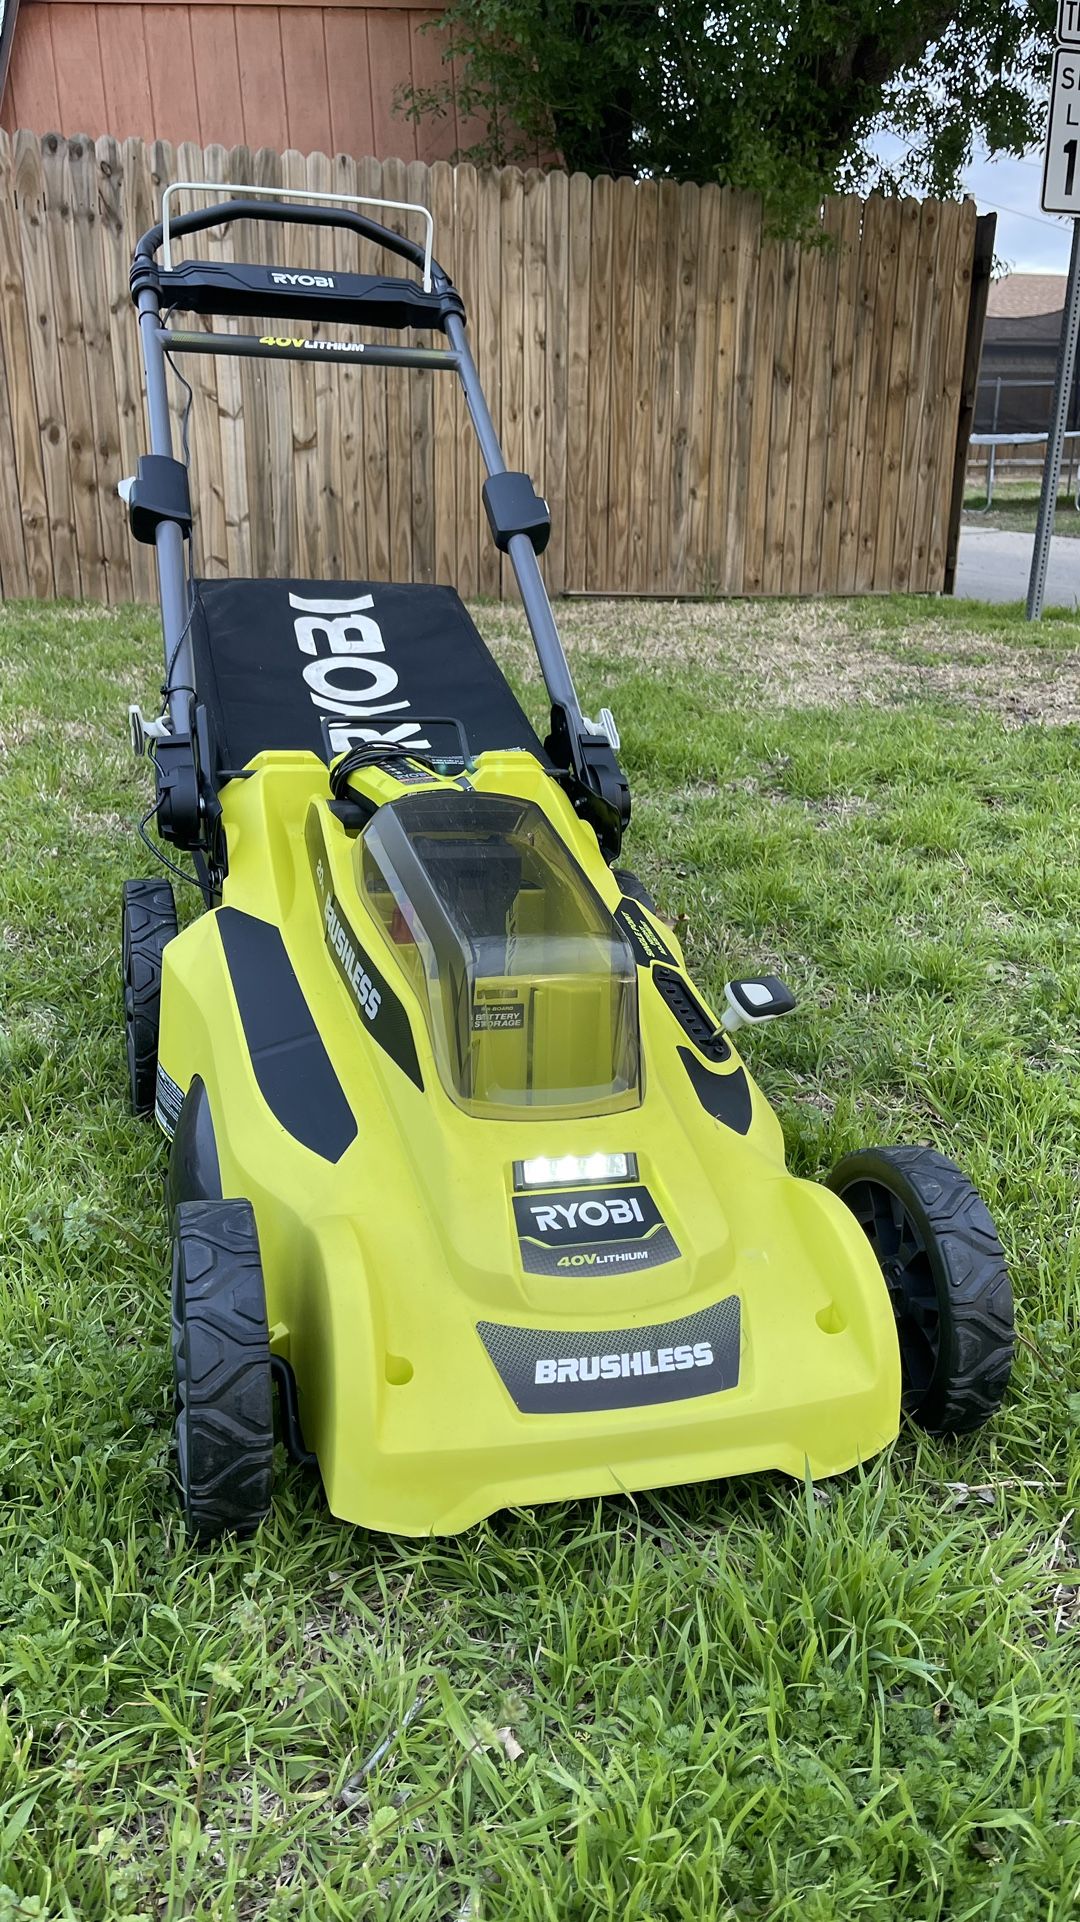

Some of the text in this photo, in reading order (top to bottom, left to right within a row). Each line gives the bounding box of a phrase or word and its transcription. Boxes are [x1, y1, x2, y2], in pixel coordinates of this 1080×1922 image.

[1066, 1, 1080, 31] T
[1061, 67, 1080, 90] S
[1066, 103, 1080, 125] L
[271, 272, 335, 288] RYOBI
[324, 890, 382, 1020] BRUSHLESS
[530, 1197, 645, 1232] RYOBI
[534, 1341, 715, 1385] BRUSHLESS
